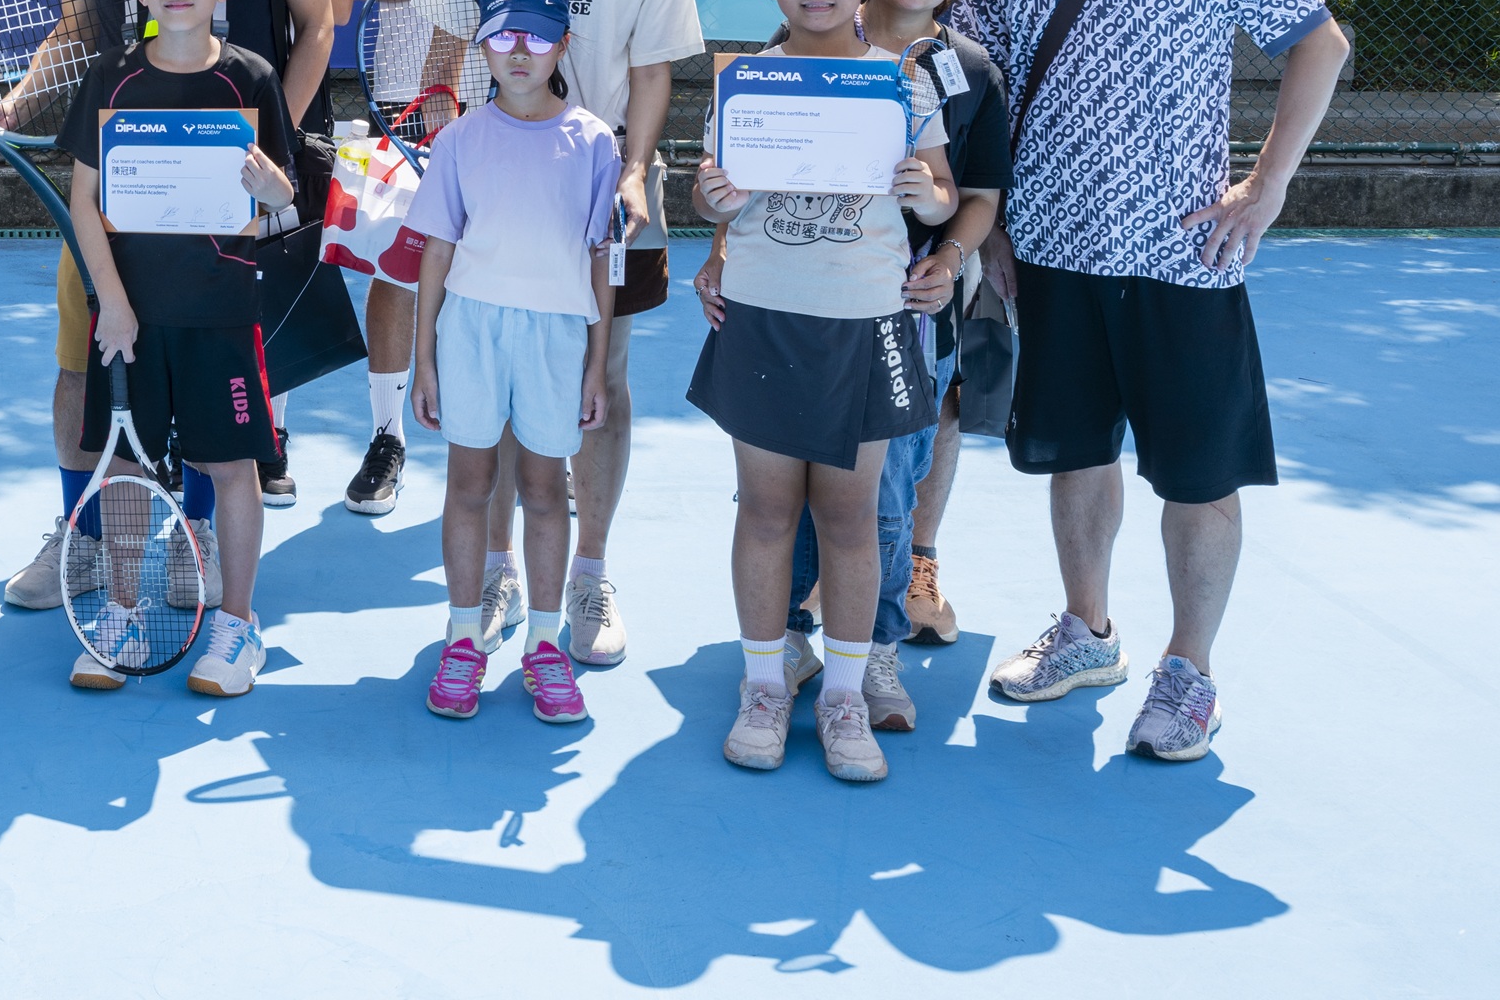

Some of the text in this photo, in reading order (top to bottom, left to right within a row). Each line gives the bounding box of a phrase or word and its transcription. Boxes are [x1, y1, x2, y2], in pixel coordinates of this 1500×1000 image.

[736, 70, 802, 81] DIPLOMA
[731, 117, 764, 128] 王云彤
[116, 124, 167, 133] DIPLOMA
[772, 218, 818, 239] 熊甜蜜
[230, 377, 250, 425] KIDS
[449, 647, 481, 660] SKECHERS
[528, 652, 562, 661] SKECHERS
